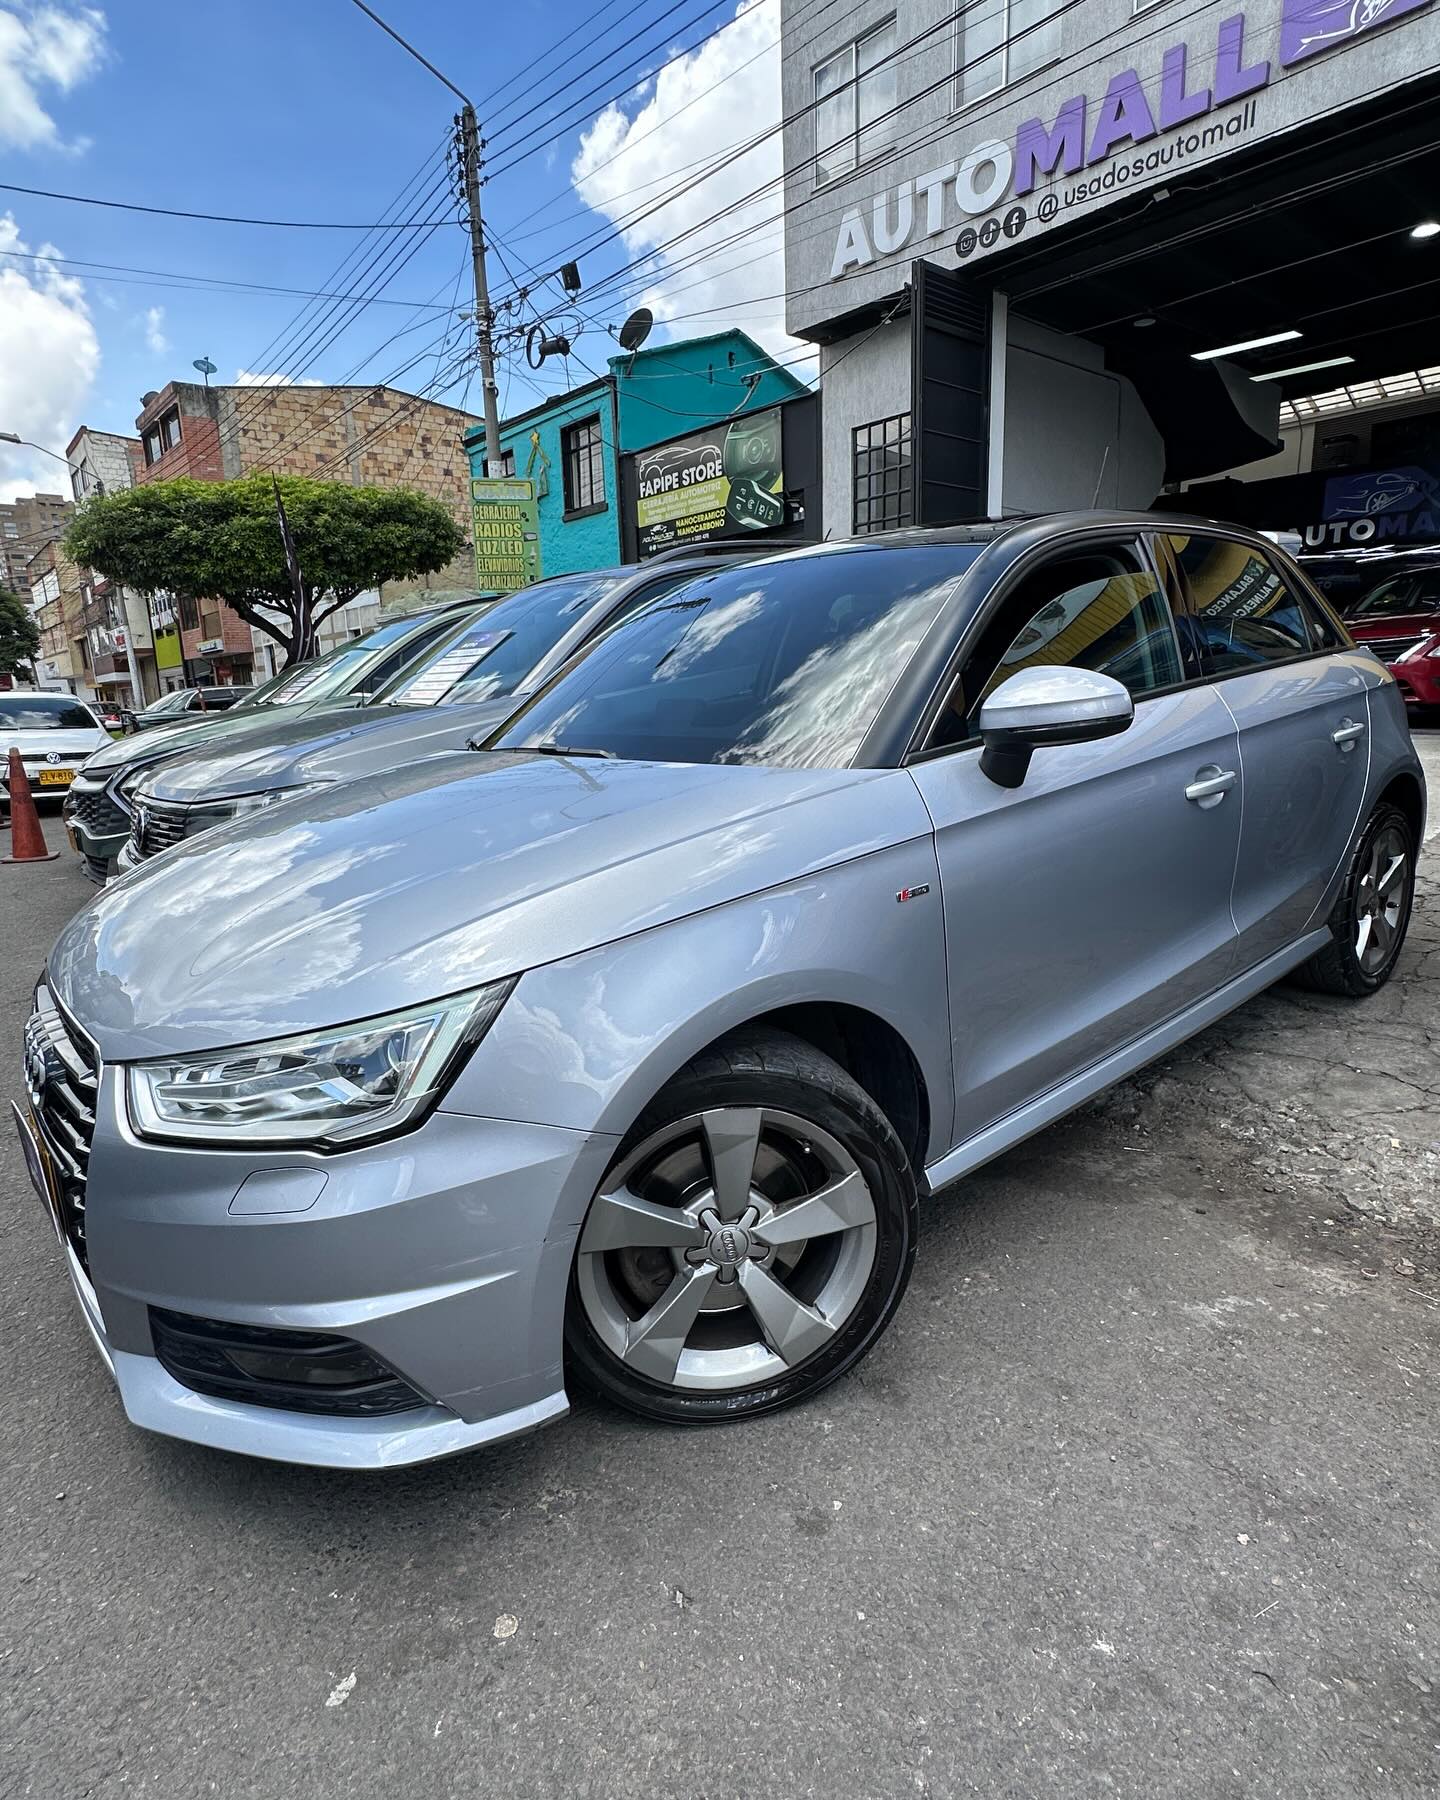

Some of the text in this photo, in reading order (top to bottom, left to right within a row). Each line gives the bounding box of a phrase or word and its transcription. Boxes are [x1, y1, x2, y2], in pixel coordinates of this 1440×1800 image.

[830, 13, 1271, 281] AUTOMALL
[640, 460, 723, 498] FAPIPE STORE
[473, 505, 520, 520] CERRAJERIA
[474, 523, 522, 538] RADIOS
[476, 540, 523, 555] LUZ LED
[477, 558, 525, 573] ELEVAVIDRIOS
[479, 575, 526, 590] POLARIZADOS
